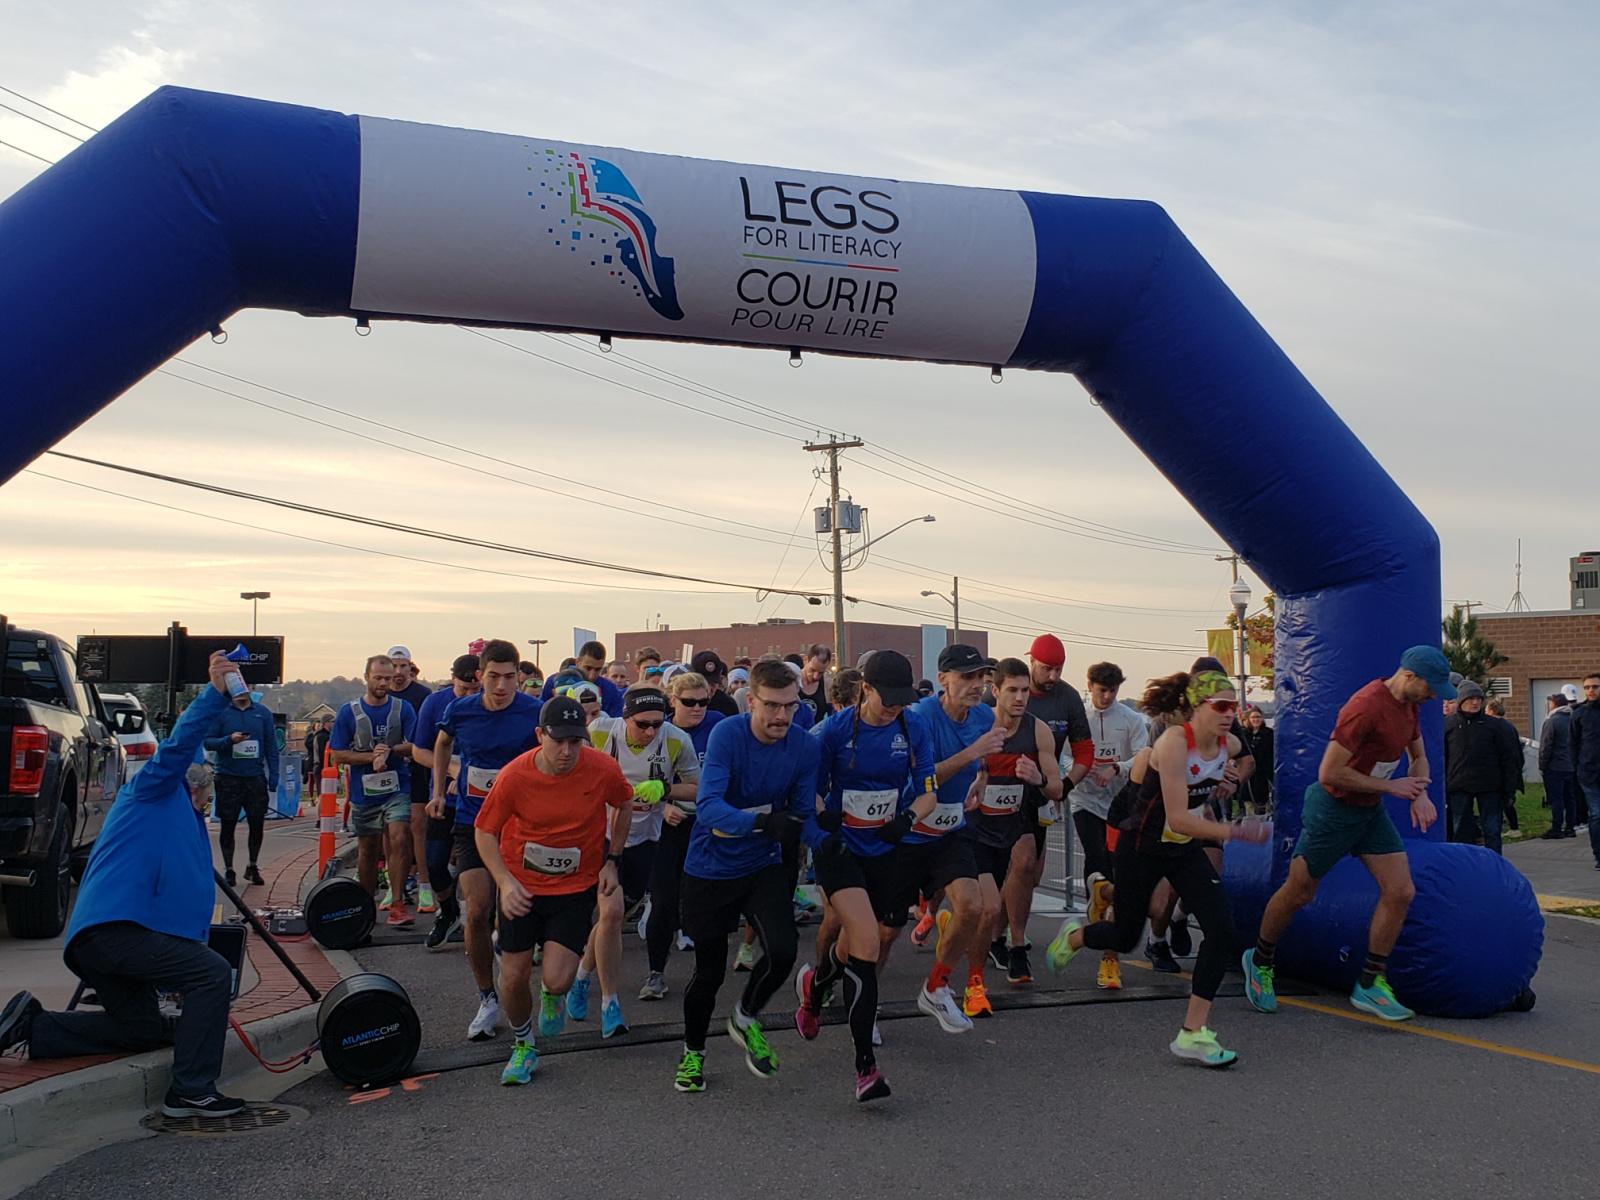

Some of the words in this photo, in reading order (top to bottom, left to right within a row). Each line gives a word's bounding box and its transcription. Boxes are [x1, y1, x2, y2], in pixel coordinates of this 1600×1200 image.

[739, 176, 899, 234] LEGS
[743, 225, 787, 248] FOR
[798, 231, 902, 259] LITERACY
[736, 268, 898, 316] COURIR
[731, 307, 815, 333] POUR
[824, 316, 889, 339] LIRE
[1100, 748, 1116, 756] 761
[380, 779, 392, 787] 85
[996, 795, 1017, 805] 463
[867, 803, 890, 816] 617
[935, 815, 958, 826] 649
[545, 858, 572, 868] 339
